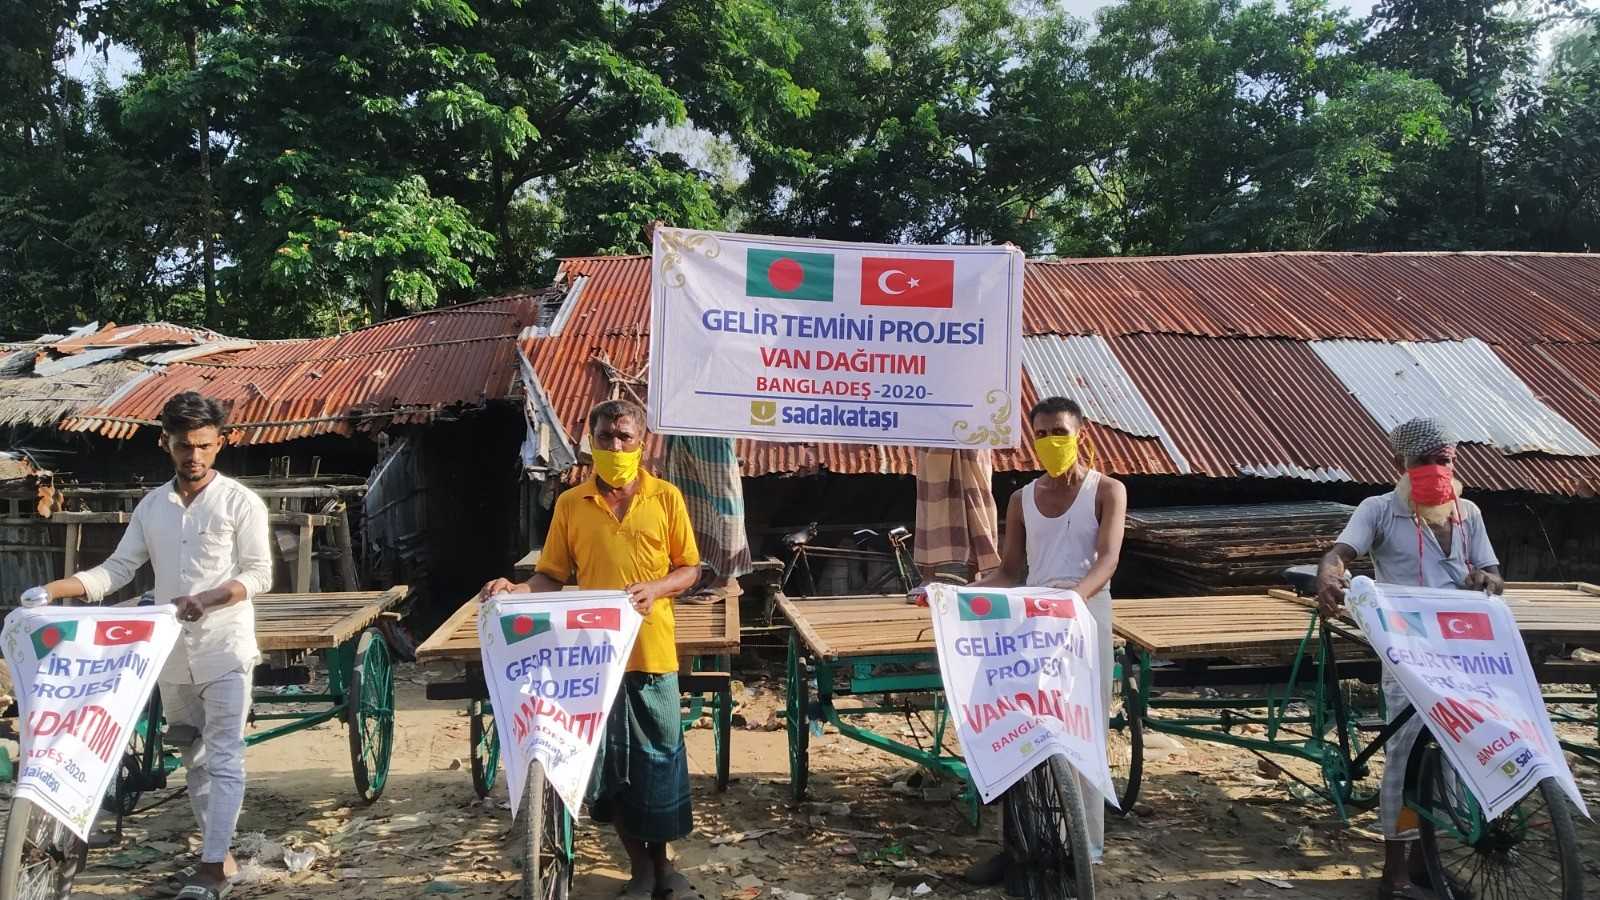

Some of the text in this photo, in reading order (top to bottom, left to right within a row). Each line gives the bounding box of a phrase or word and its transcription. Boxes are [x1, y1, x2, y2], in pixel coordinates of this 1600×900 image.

[702, 308, 985, 345] GELİR TEMİNİ PROJESİ
[760, 347, 926, 375] VAN DAĞITIMI
[756, 377, 871, 400] BANGLADEŞ
[782, 404, 899, 431] sadakataşı
[954, 632, 1017, 657] GELİR
[37, 650, 150, 679] LİR TEMİNİ
